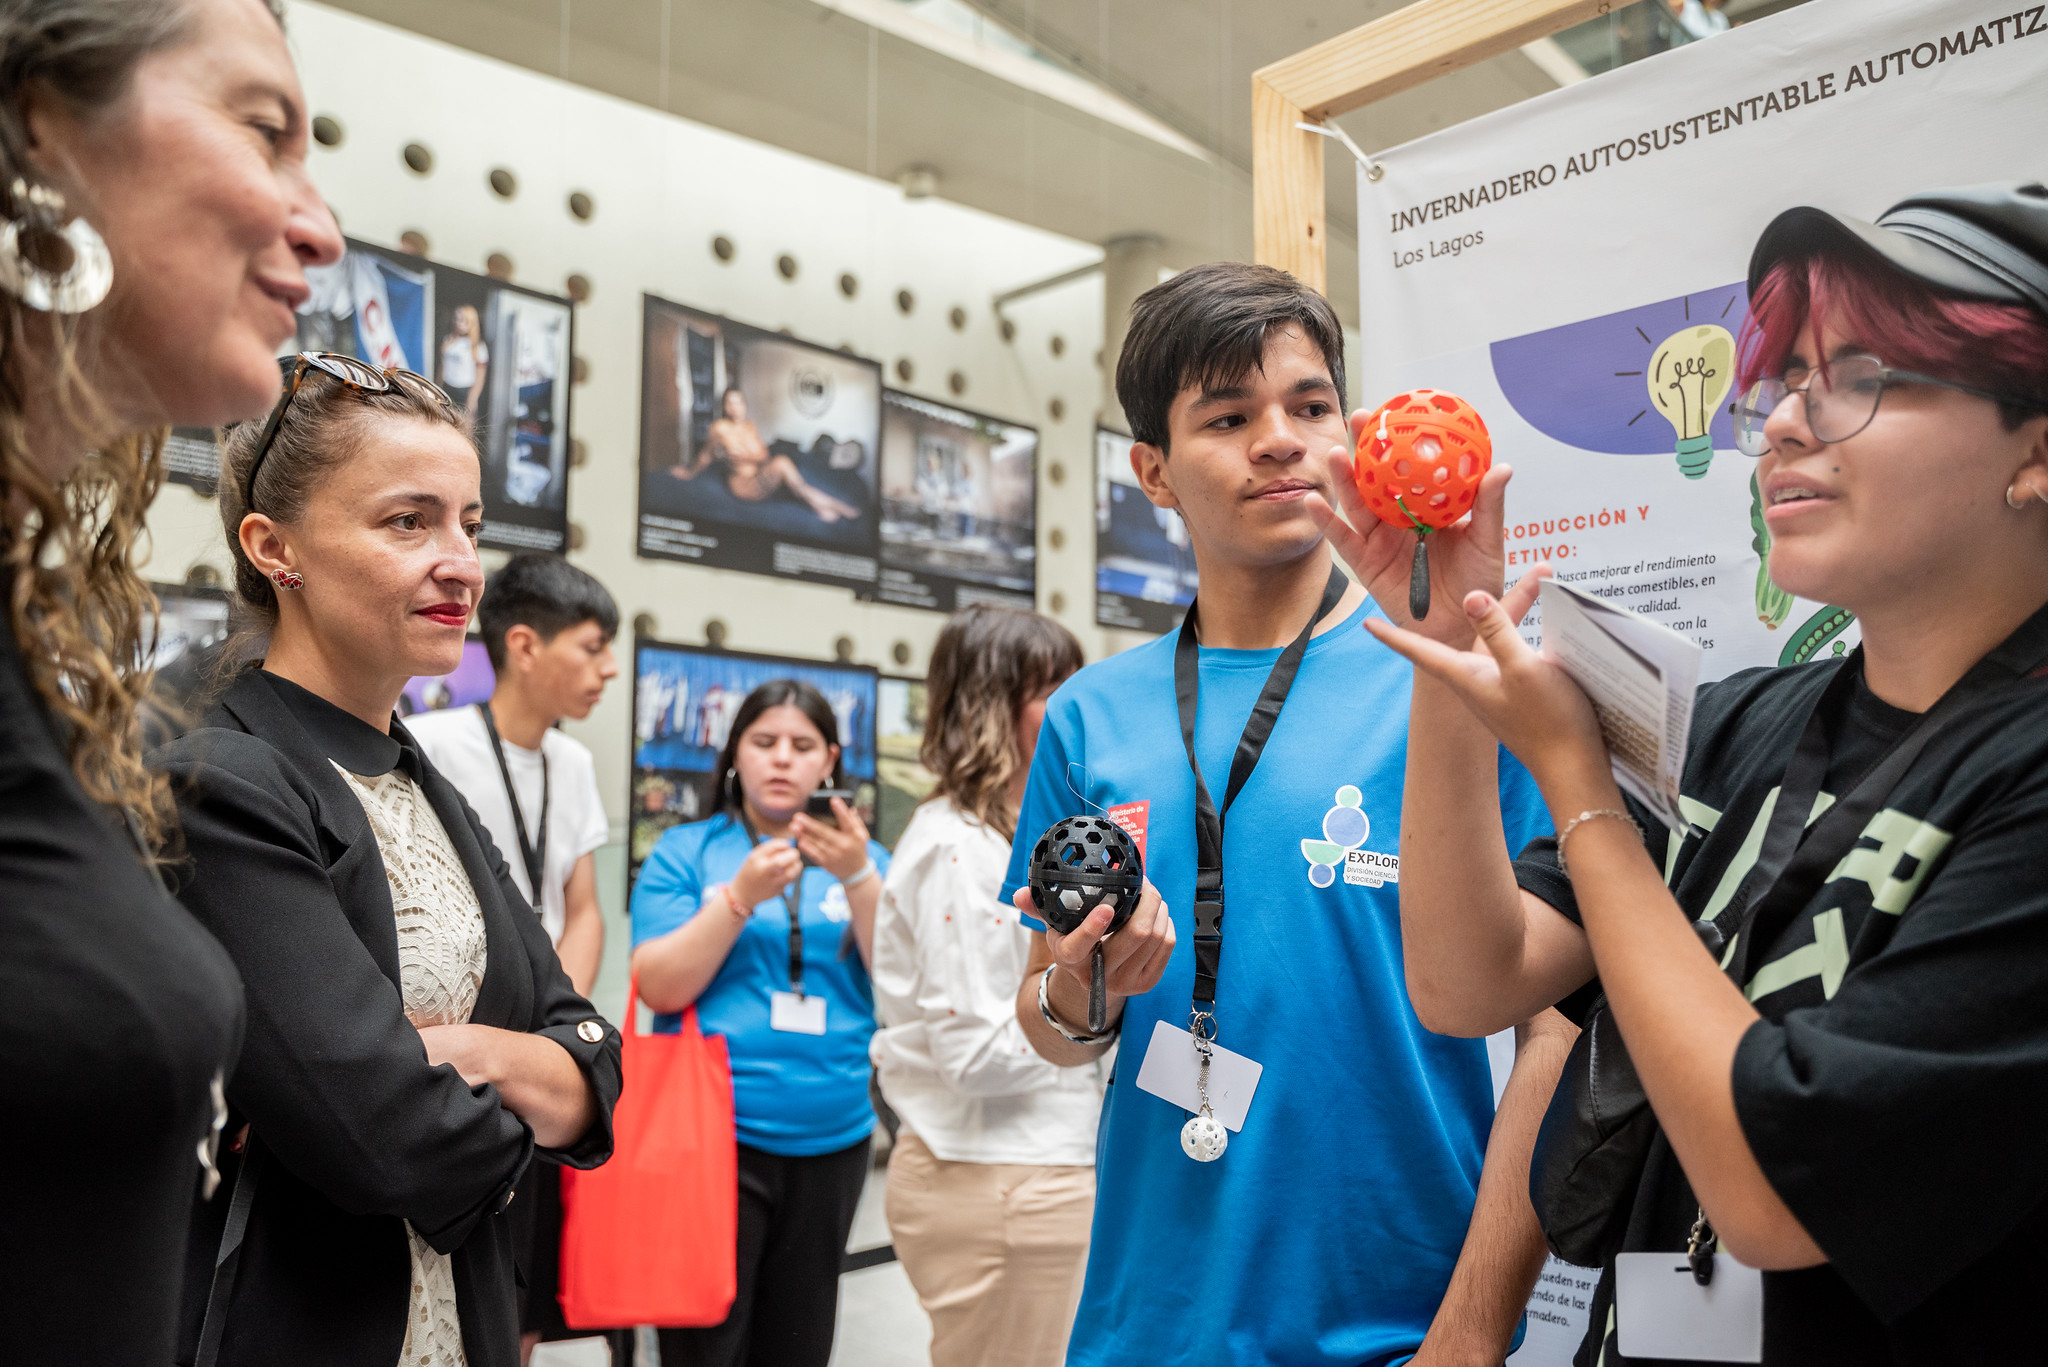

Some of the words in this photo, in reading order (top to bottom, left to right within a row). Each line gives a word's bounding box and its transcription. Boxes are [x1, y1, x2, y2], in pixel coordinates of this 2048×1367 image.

[1391, 164, 1556, 232] INVERNADERO
[1564, 73, 1836, 180] AUTOSUSTENTABLE
[1844, 5, 2048, 92] AUTOMATIZ
[1393, 249, 1424, 268] Los
[1430, 230, 1484, 257] Lagos
[1638, 505, 1650, 521] Y
[1557, 571, 1587, 582] busca
[1589, 565, 1631, 580] mejorar
[1634, 560, 1644, 573] el
[1646, 553, 1716, 571] rendimiento
[1627, 577, 1699, 596] comestibles,
[1701, 574, 1716, 587] en
[1637, 596, 1681, 614] calidad.
[1672, 620, 1693, 631] con
[1696, 616, 1707, 629] la
[1348, 852, 1398, 869] EXPLOR
[1347, 867, 1373, 875] DIVISIÓN
[1374, 871, 1396, 880] CIENCIA
[1351, 876, 1381, 885] SOCIEDAD
[1575, 1280, 1591, 1290] ser
[1557, 1294, 1570, 1307] de
[1572, 1296, 1585, 1310] las
